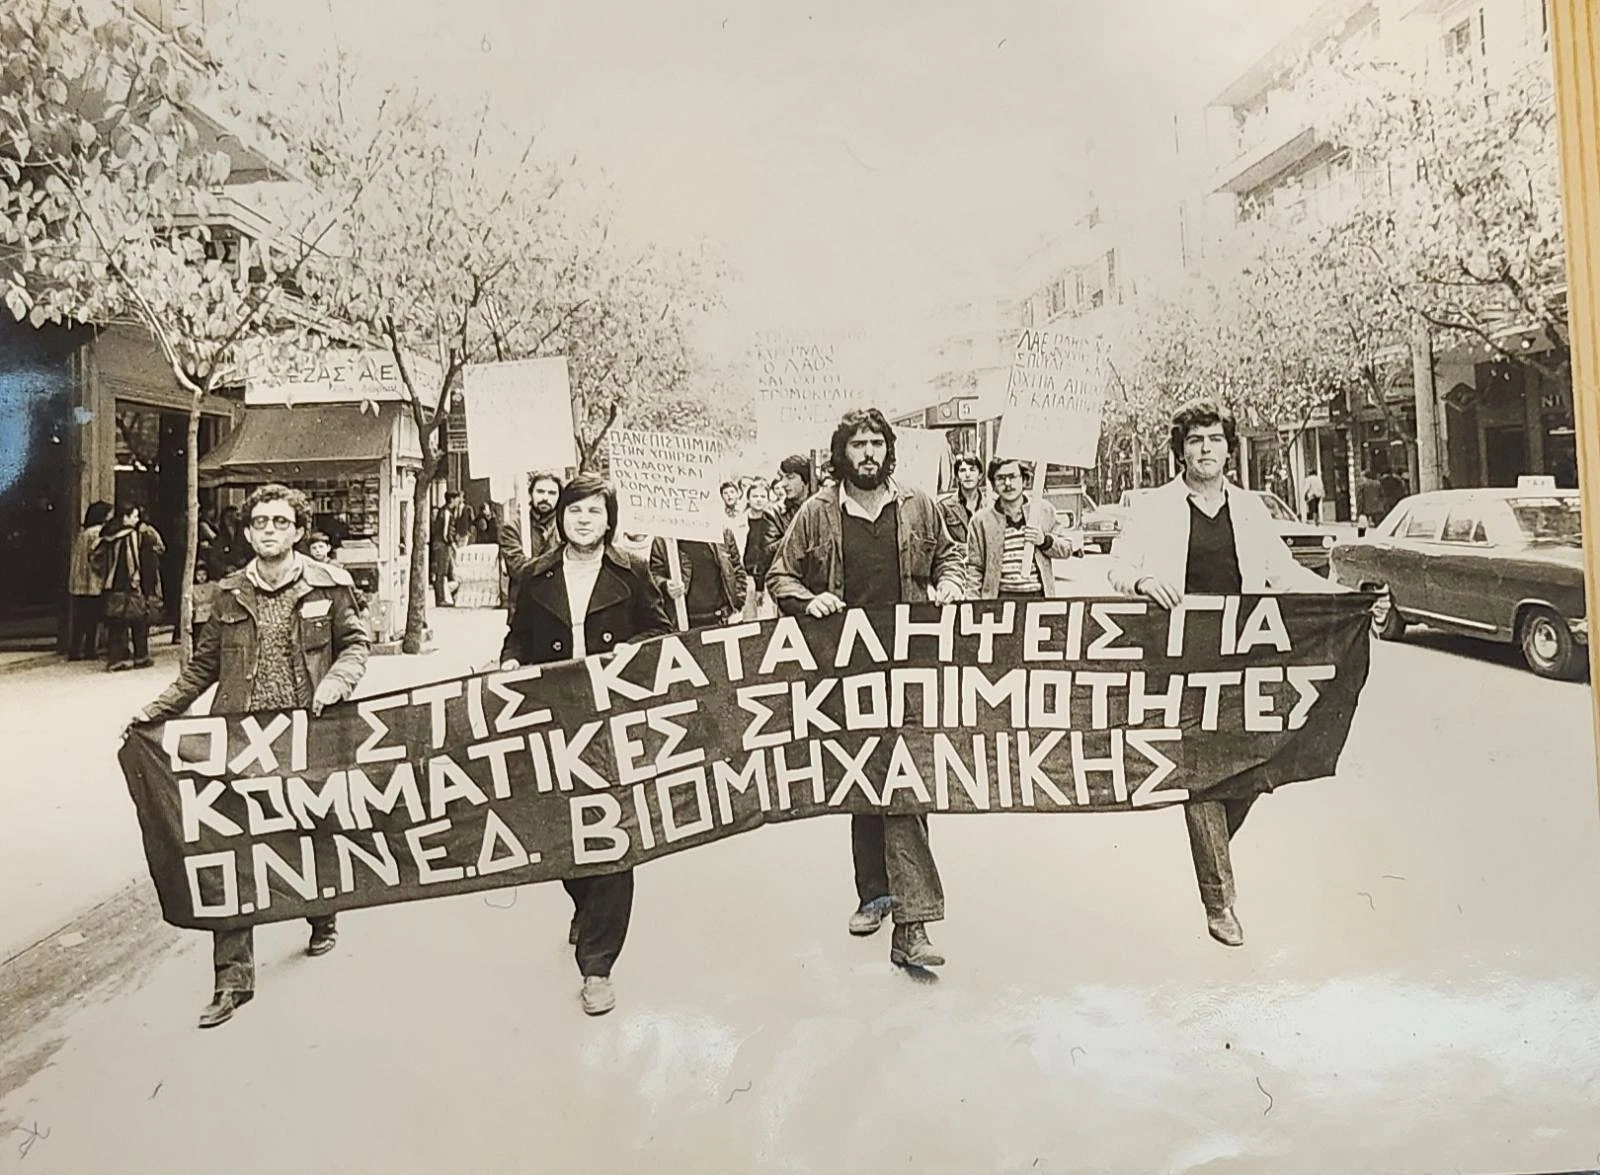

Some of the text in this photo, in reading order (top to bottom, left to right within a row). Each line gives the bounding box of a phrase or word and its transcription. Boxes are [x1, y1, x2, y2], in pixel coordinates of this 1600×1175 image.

[162, 594, 1293, 776] ΟΧΙ ΣΤΙΣ ΚΑΤΑΛΗΨΕΙΣ ΓΙΑ
[178, 664, 1337, 844] ΚΟΜΜΑΤΙΚΕΣ ΣΚΟΠΙΜΟΤΗΤΕΣ
[568, 728, 1191, 867] ΒΙΟΜΗΧΑΝΙΚΗΣ
